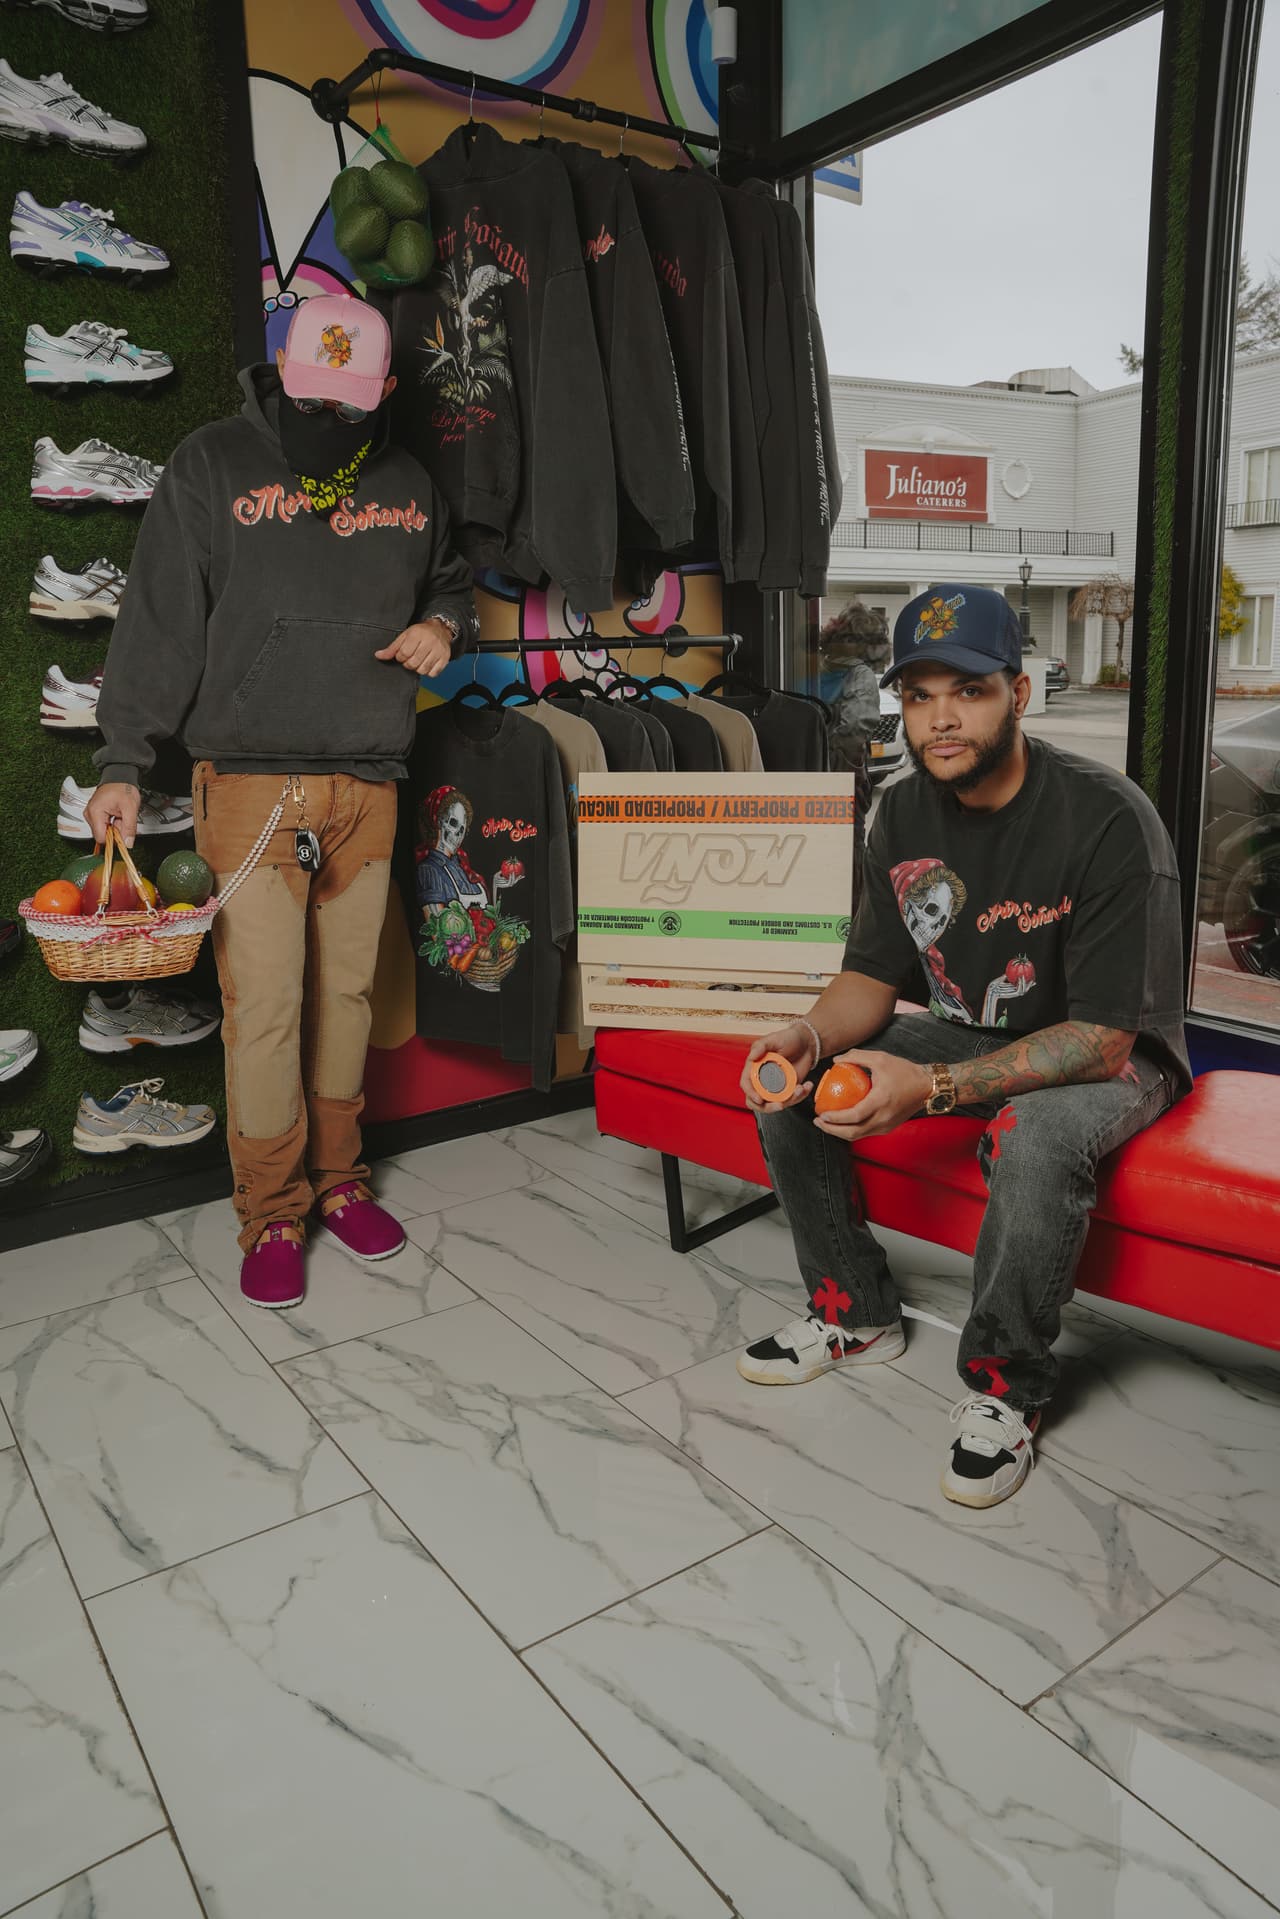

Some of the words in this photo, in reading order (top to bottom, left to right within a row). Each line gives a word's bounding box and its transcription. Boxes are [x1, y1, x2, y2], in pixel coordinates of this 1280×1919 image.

[885, 464, 967, 499] Juliano's
[917, 497, 967, 507] CATERERS
[329, 496, 428, 537] Soñando
[624, 800, 706, 817] PROPIEDAD
[723, 800, 799, 818] PROPERTY
[805, 800, 855, 818] SEIZED
[590, 914, 620, 922] FRONTERIZA
[614, 922, 644, 930] EXAMINADO
[795, 921, 821, 929] CUSTOMS
[770, 928, 798, 936] EXAMINED
